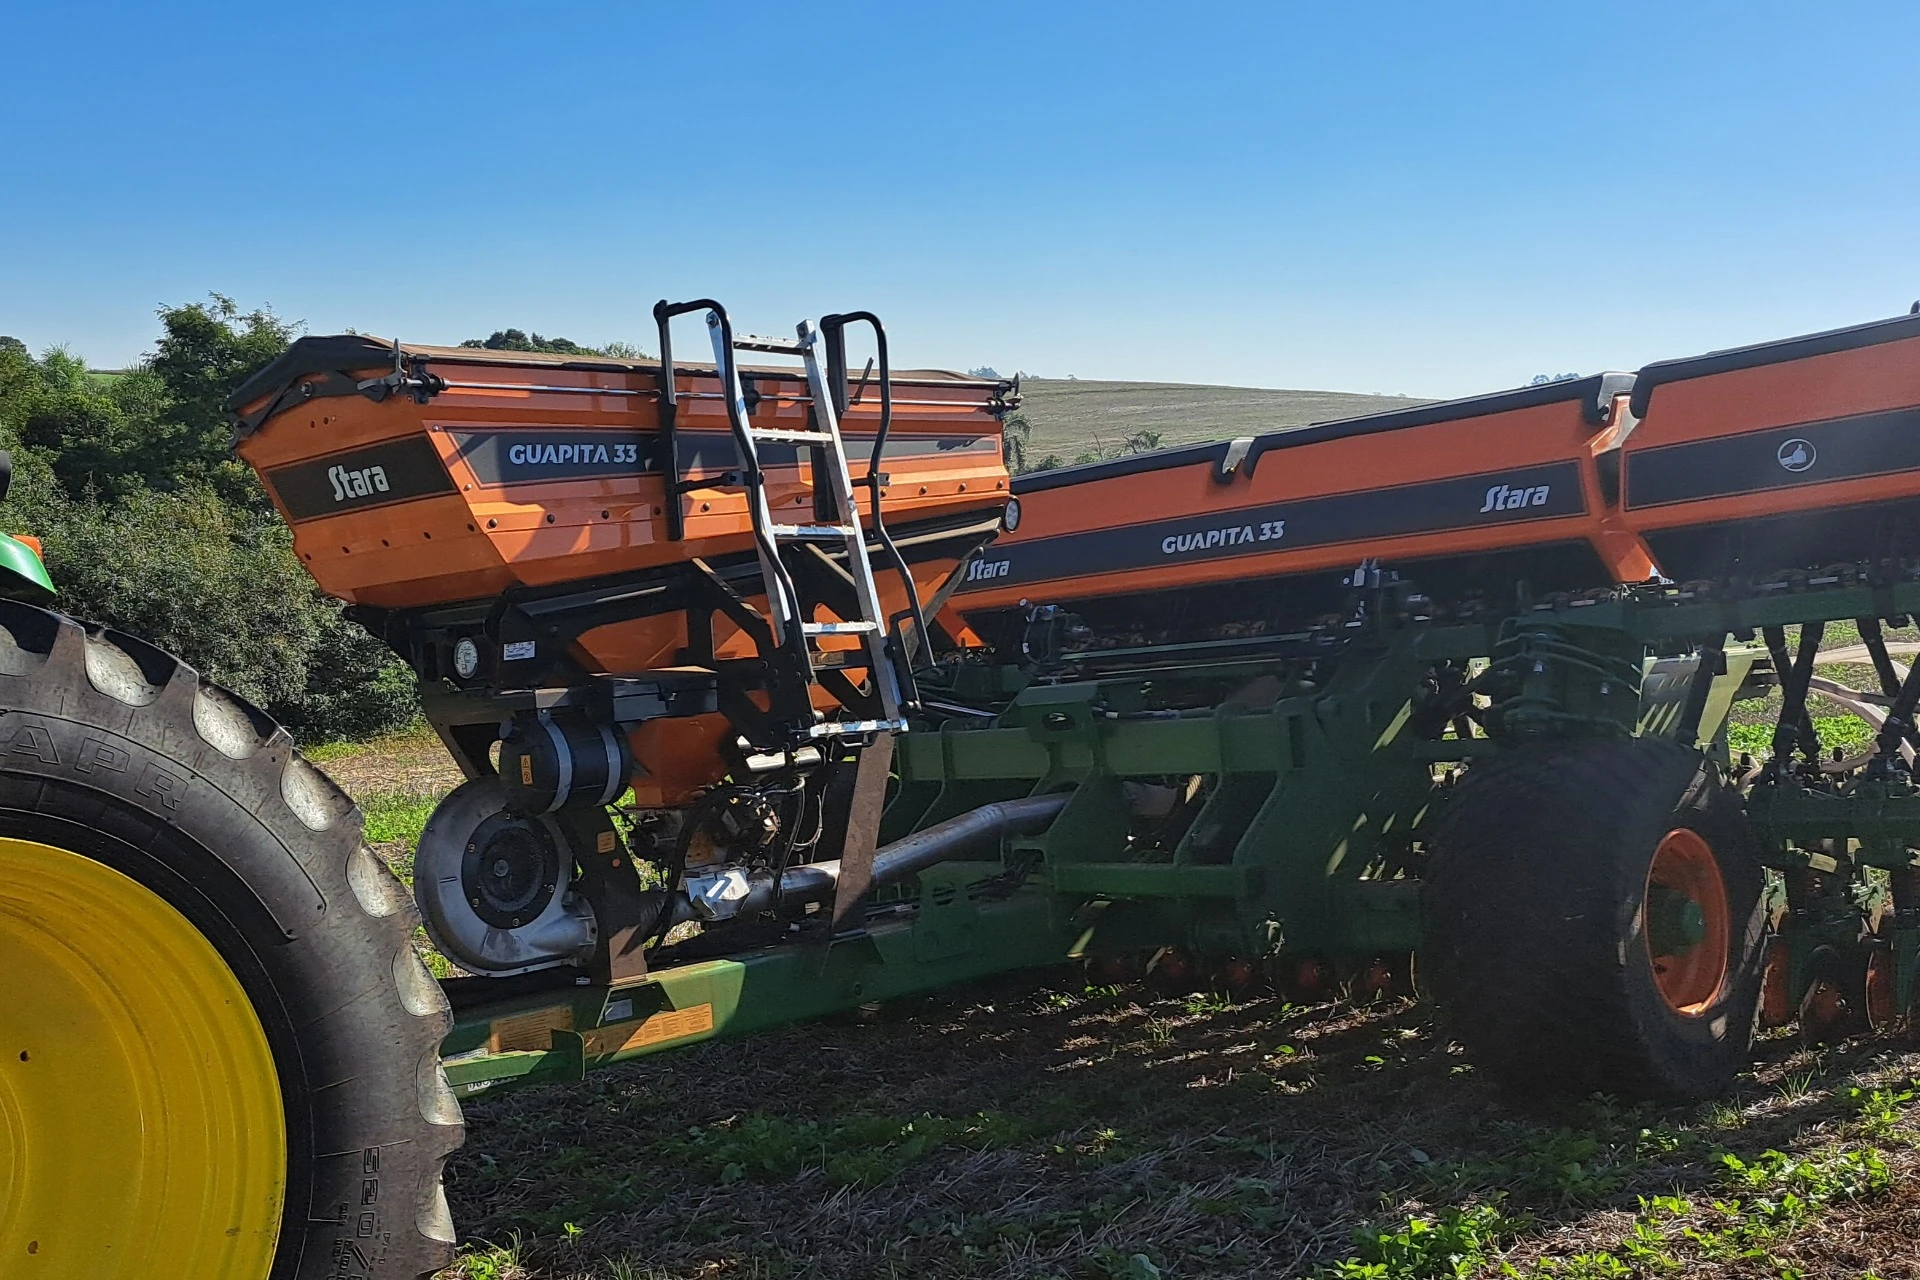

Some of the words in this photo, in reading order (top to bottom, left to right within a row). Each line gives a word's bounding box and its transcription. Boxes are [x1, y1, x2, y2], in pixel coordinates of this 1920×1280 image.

[509, 444, 609, 464] GUAPITA
[613, 444, 638, 463] 33
[328, 465, 390, 501] Stara
[1480, 485, 1550, 513] Stara
[1162, 526, 1254, 553] GUAPITA
[1259, 521, 1285, 541] 33
[967, 559, 1010, 581] Stara
